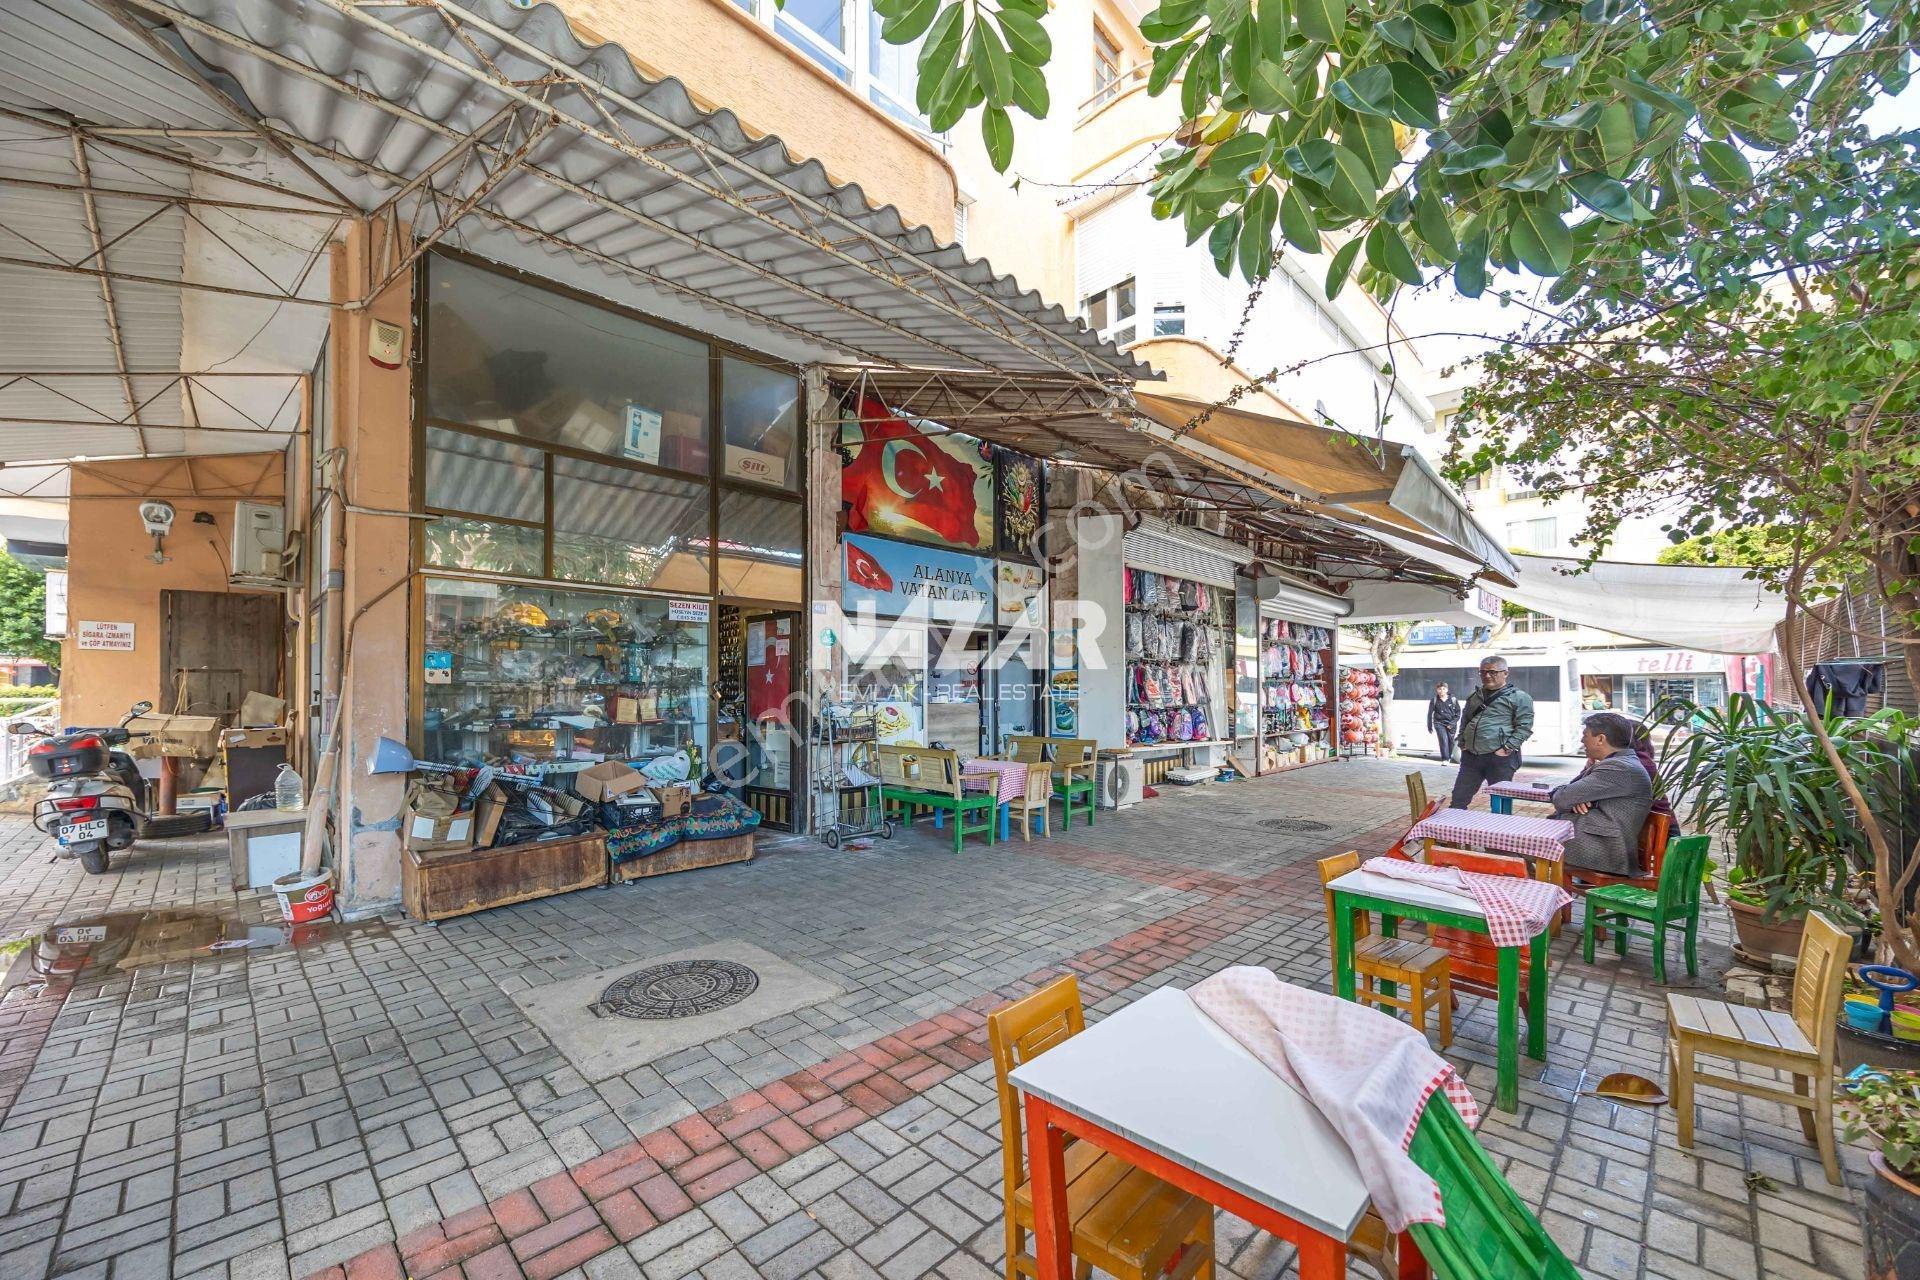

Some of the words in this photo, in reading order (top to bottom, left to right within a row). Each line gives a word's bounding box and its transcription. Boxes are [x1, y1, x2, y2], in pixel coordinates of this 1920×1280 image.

[912, 564, 973, 586] ALANYA
[900, 581, 948, 600] VATAN
[952, 588, 988, 605] CAFE
[669, 602, 691, 610] SEZEN
[96, 623, 118, 631] LÜTFEN
[1637, 652, 1694, 673] telli
[61, 825, 76, 835] 07
[79, 820, 105, 832] HLC
[78, 831, 94, 840] 04
